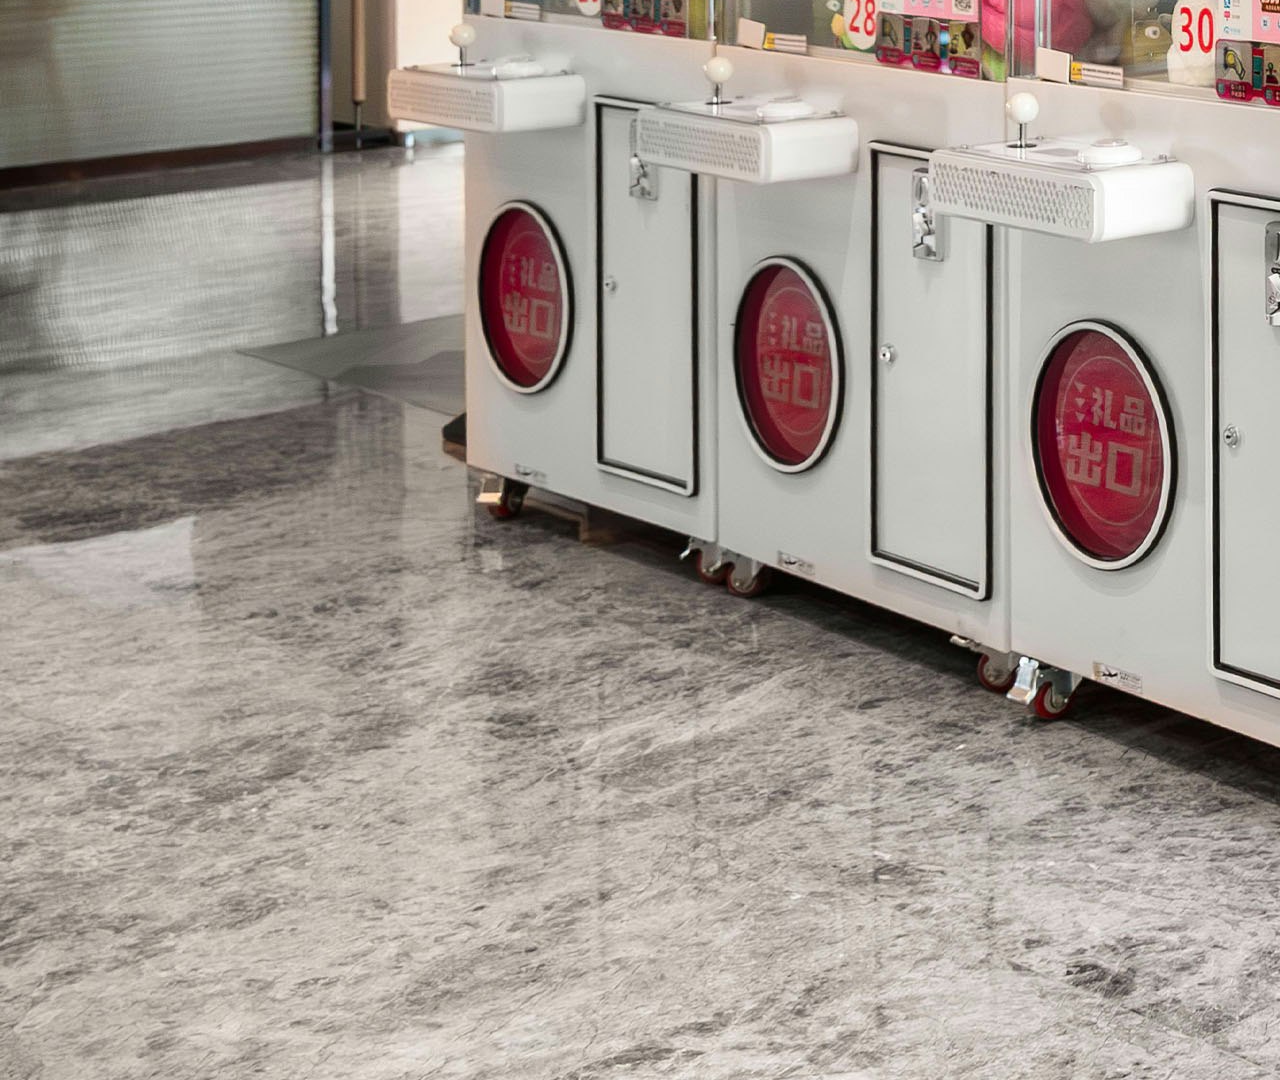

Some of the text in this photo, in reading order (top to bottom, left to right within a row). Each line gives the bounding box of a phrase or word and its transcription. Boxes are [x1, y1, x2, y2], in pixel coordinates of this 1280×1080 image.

[1179, 6, 1214, 54] 30
[519, 256, 557, 292] 礼品
[503, 291, 557, 340] 出口
[779, 314, 825, 357] 礼品
[762, 353, 829, 410] 出口
[1091, 386, 1148, 438] 礼品
[1065, 431, 1144, 497] 出口
